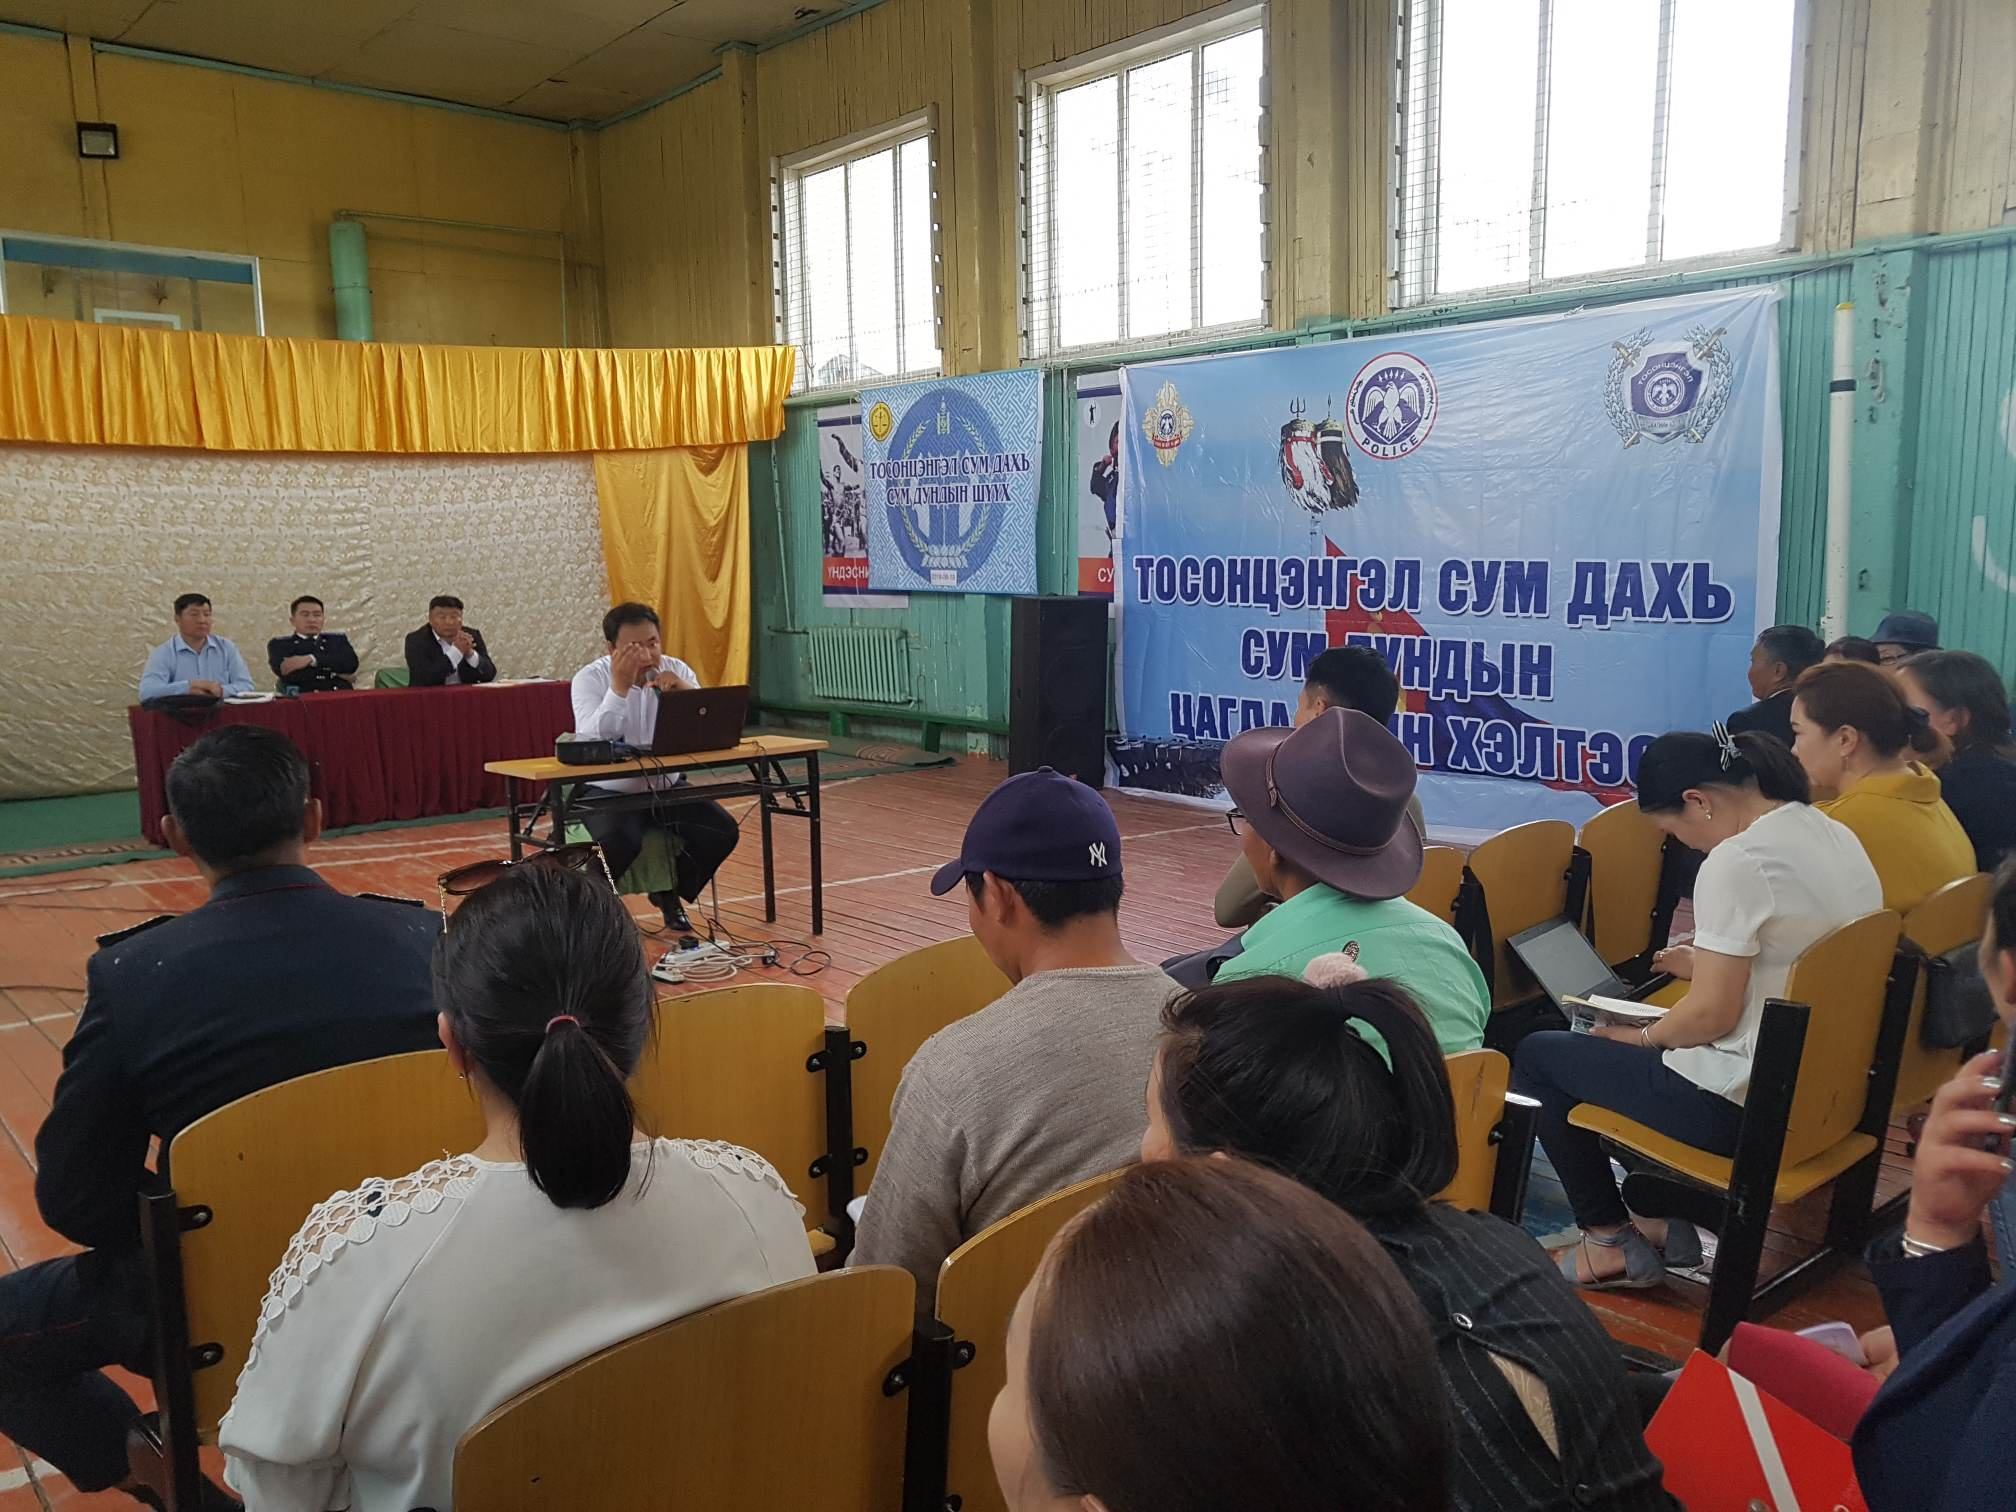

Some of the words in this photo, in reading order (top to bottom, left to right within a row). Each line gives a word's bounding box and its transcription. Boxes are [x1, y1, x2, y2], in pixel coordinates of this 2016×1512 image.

[1361, 435, 1418, 456] POLICE
[870, 457, 957, 479] ТОСОНЦЭНГЭЛ
[961, 455, 989, 475] СУМ
[993, 453, 1030, 473] ДАХЬ
[887, 488, 910, 505] СУМ
[914, 485, 968, 506] ДУНДЫН
[1133, 556, 1422, 615] ТОСОНЦЭНГЭЛ
[1438, 559, 1549, 617] СУМ
[1566, 560, 1734, 628] ДАХЬ
[1241, 628, 1328, 680] СУМ
[1346, 633, 1554, 701] УНДЫН
[1089, 842, 1108, 867] NY
